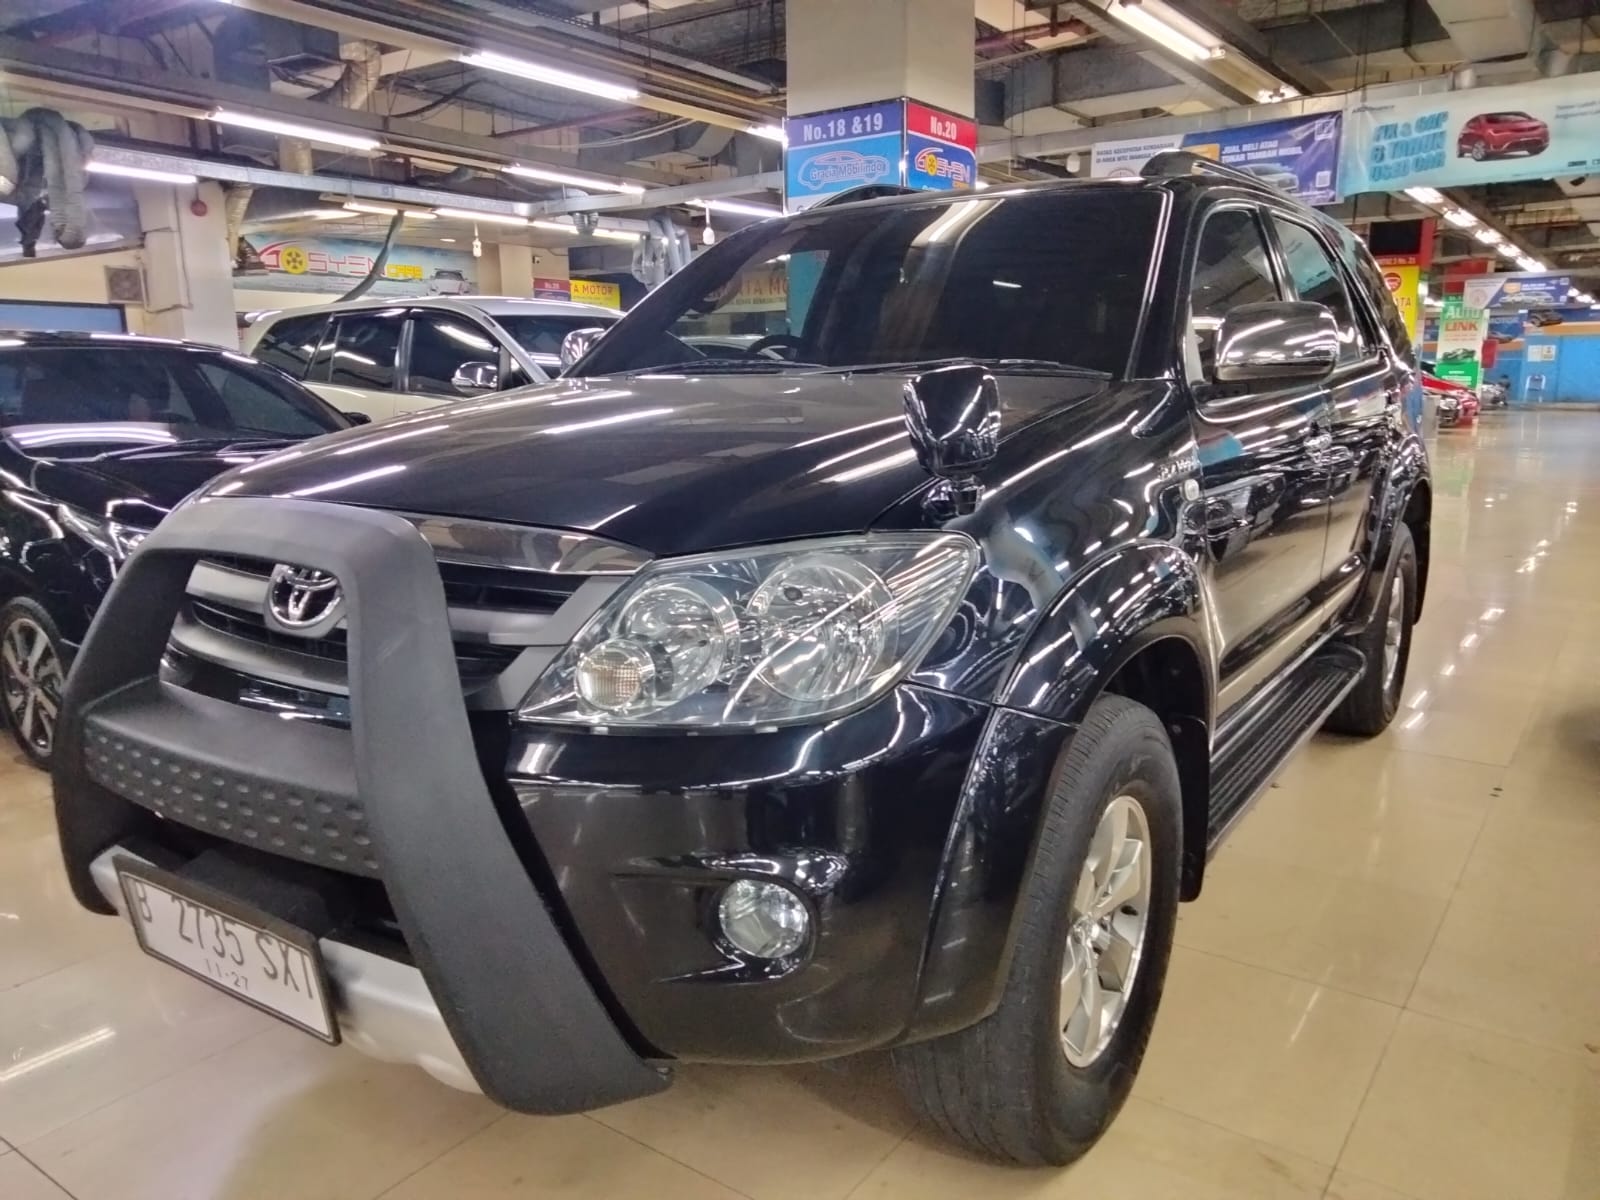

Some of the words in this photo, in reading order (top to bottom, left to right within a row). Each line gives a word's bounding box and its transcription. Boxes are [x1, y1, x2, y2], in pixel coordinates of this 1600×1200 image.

[803, 118, 846, 142] No.18
[851, 112, 883, 135] &19
[930, 115, 957, 140] No.20
[582, 284, 613, 296] MOTOR
[1444, 321, 1478, 332] LINK
[134, 882, 152, 923] B
[170, 894, 245, 967] 2735
